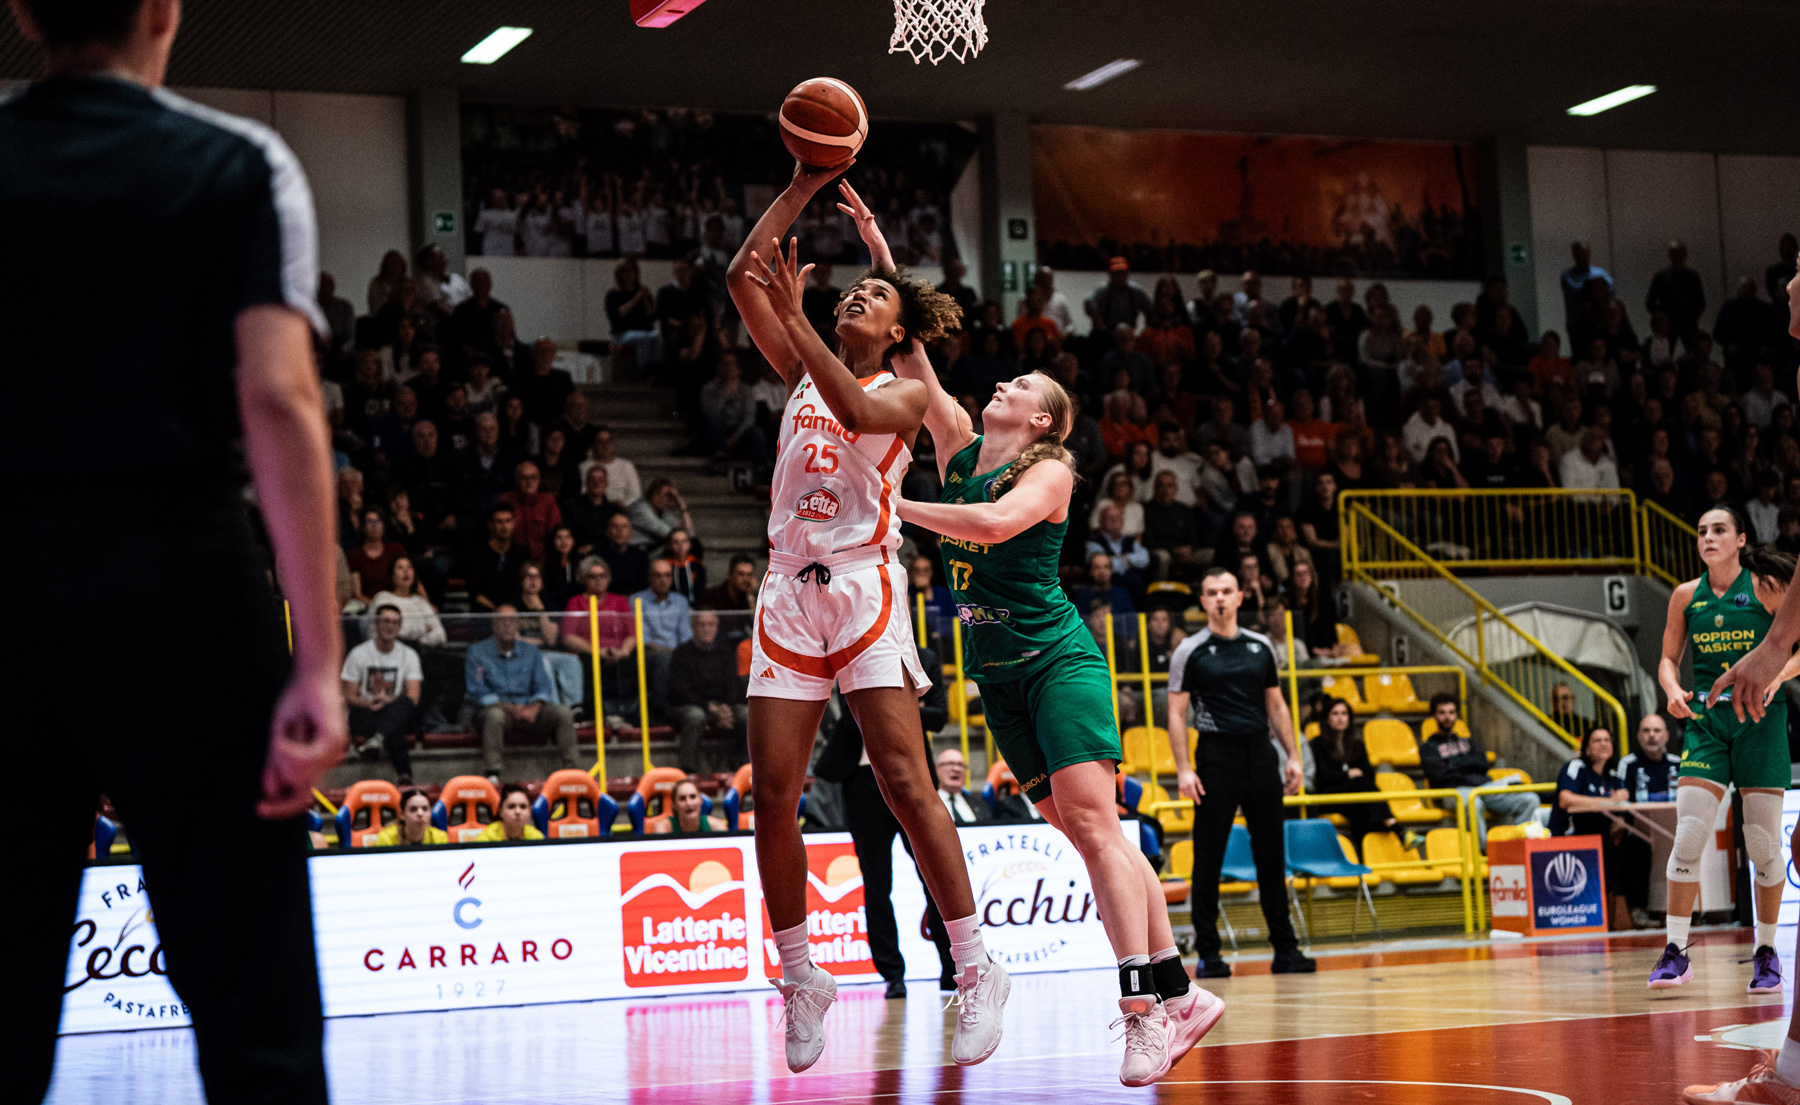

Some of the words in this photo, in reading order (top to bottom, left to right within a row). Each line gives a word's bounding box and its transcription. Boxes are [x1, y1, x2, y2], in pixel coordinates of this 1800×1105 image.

[802, 442, 839, 475] 25
[948, 558, 974, 591] 17
[1608, 580, 1625, 611] G
[1692, 629, 1755, 644] SOPRON
[966, 834, 1063, 866] FRATELLI
[101, 876, 147, 909] FRA
[1537, 903, 1598, 917] EUROLEAGUE
[1549, 914, 1587, 926] WOMEN
[642, 911, 747, 945] Latterie
[363, 937, 573, 972] CARRARO
[624, 941, 748, 975] Vicentine
[103, 991, 191, 1018] PASTAFRE
[436, 979, 506, 1000] 1927
